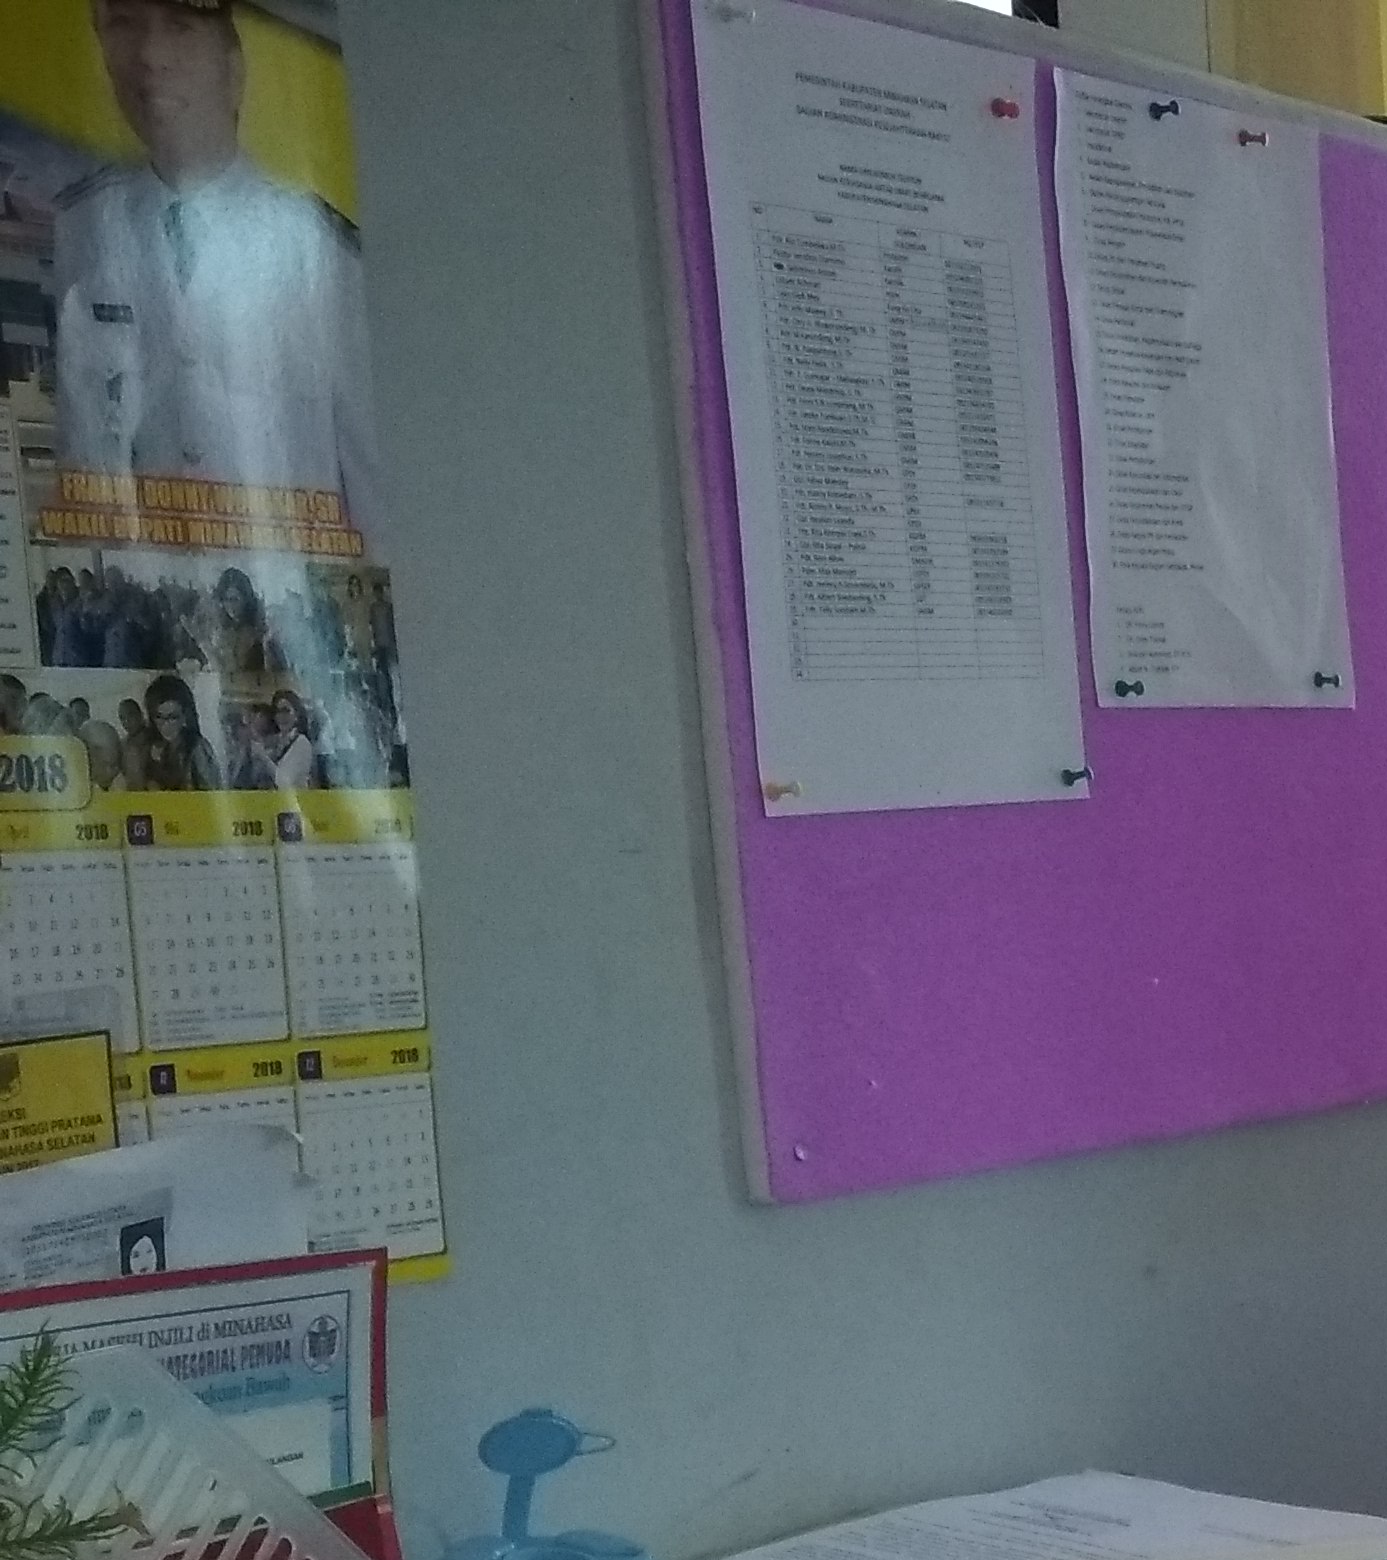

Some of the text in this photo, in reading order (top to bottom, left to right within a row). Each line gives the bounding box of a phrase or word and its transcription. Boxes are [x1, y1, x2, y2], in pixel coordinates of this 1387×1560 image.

[0, 753, 68, 793] 2018
[75, 822, 109, 842] 2018
[231, 819, 264, 838] 2018
[390, 1046, 420, 1065] 2018
[251, 1058, 283, 1078] 2018
[46, 1131, 96, 1152] SELATAN
[147, 1324, 194, 1349] INJILI
[197, 1320, 207, 1342] di
[210, 1312, 293, 1338] MINAHASA
